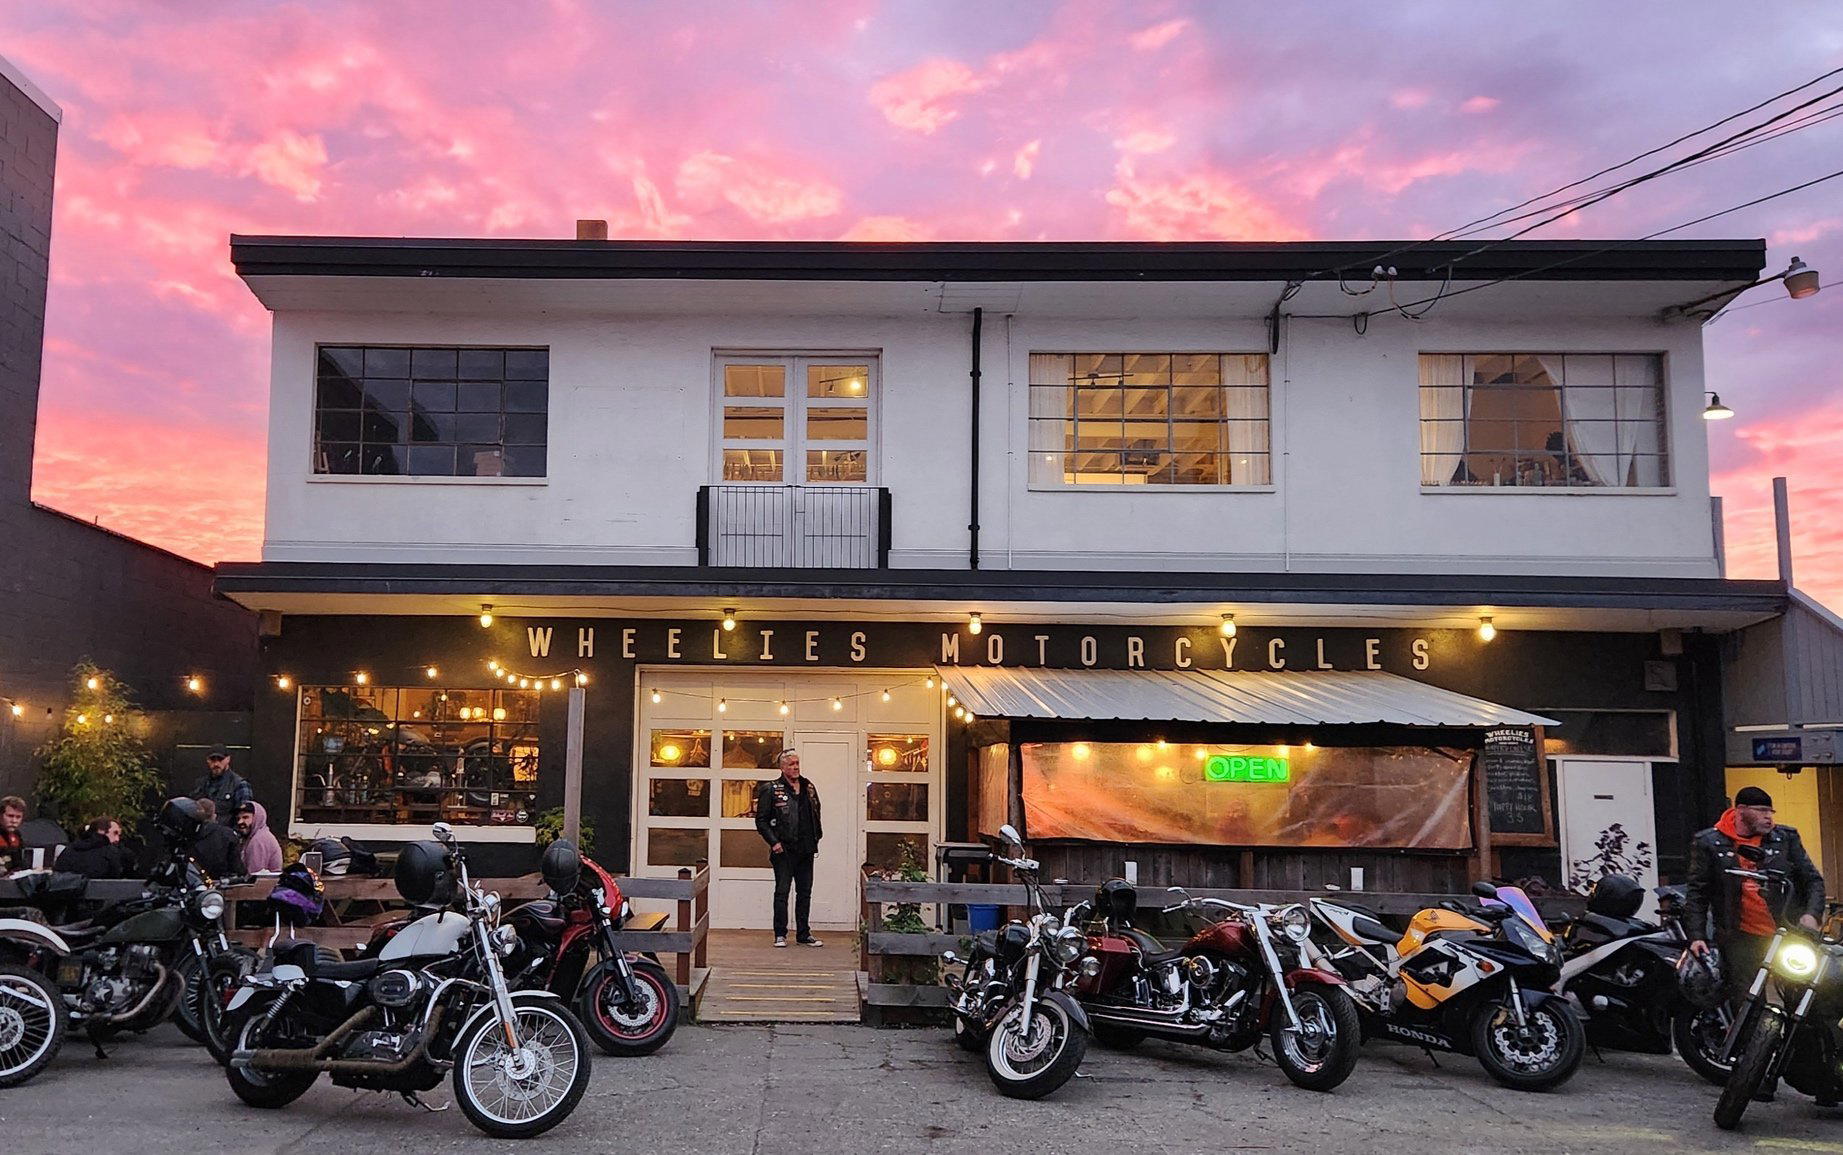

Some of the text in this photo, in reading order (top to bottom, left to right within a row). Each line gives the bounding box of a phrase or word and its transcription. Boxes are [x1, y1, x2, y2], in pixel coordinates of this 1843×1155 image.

[527, 627, 1430, 671] WHEELIES MOTORCYCLES
[1484, 736, 1534, 744] MOTORCYCLES
[1485, 729, 1529, 738] WHEELIES
[1207, 756, 1288, 779] OPEN
[1386, 1023, 1452, 1049] HONDA
